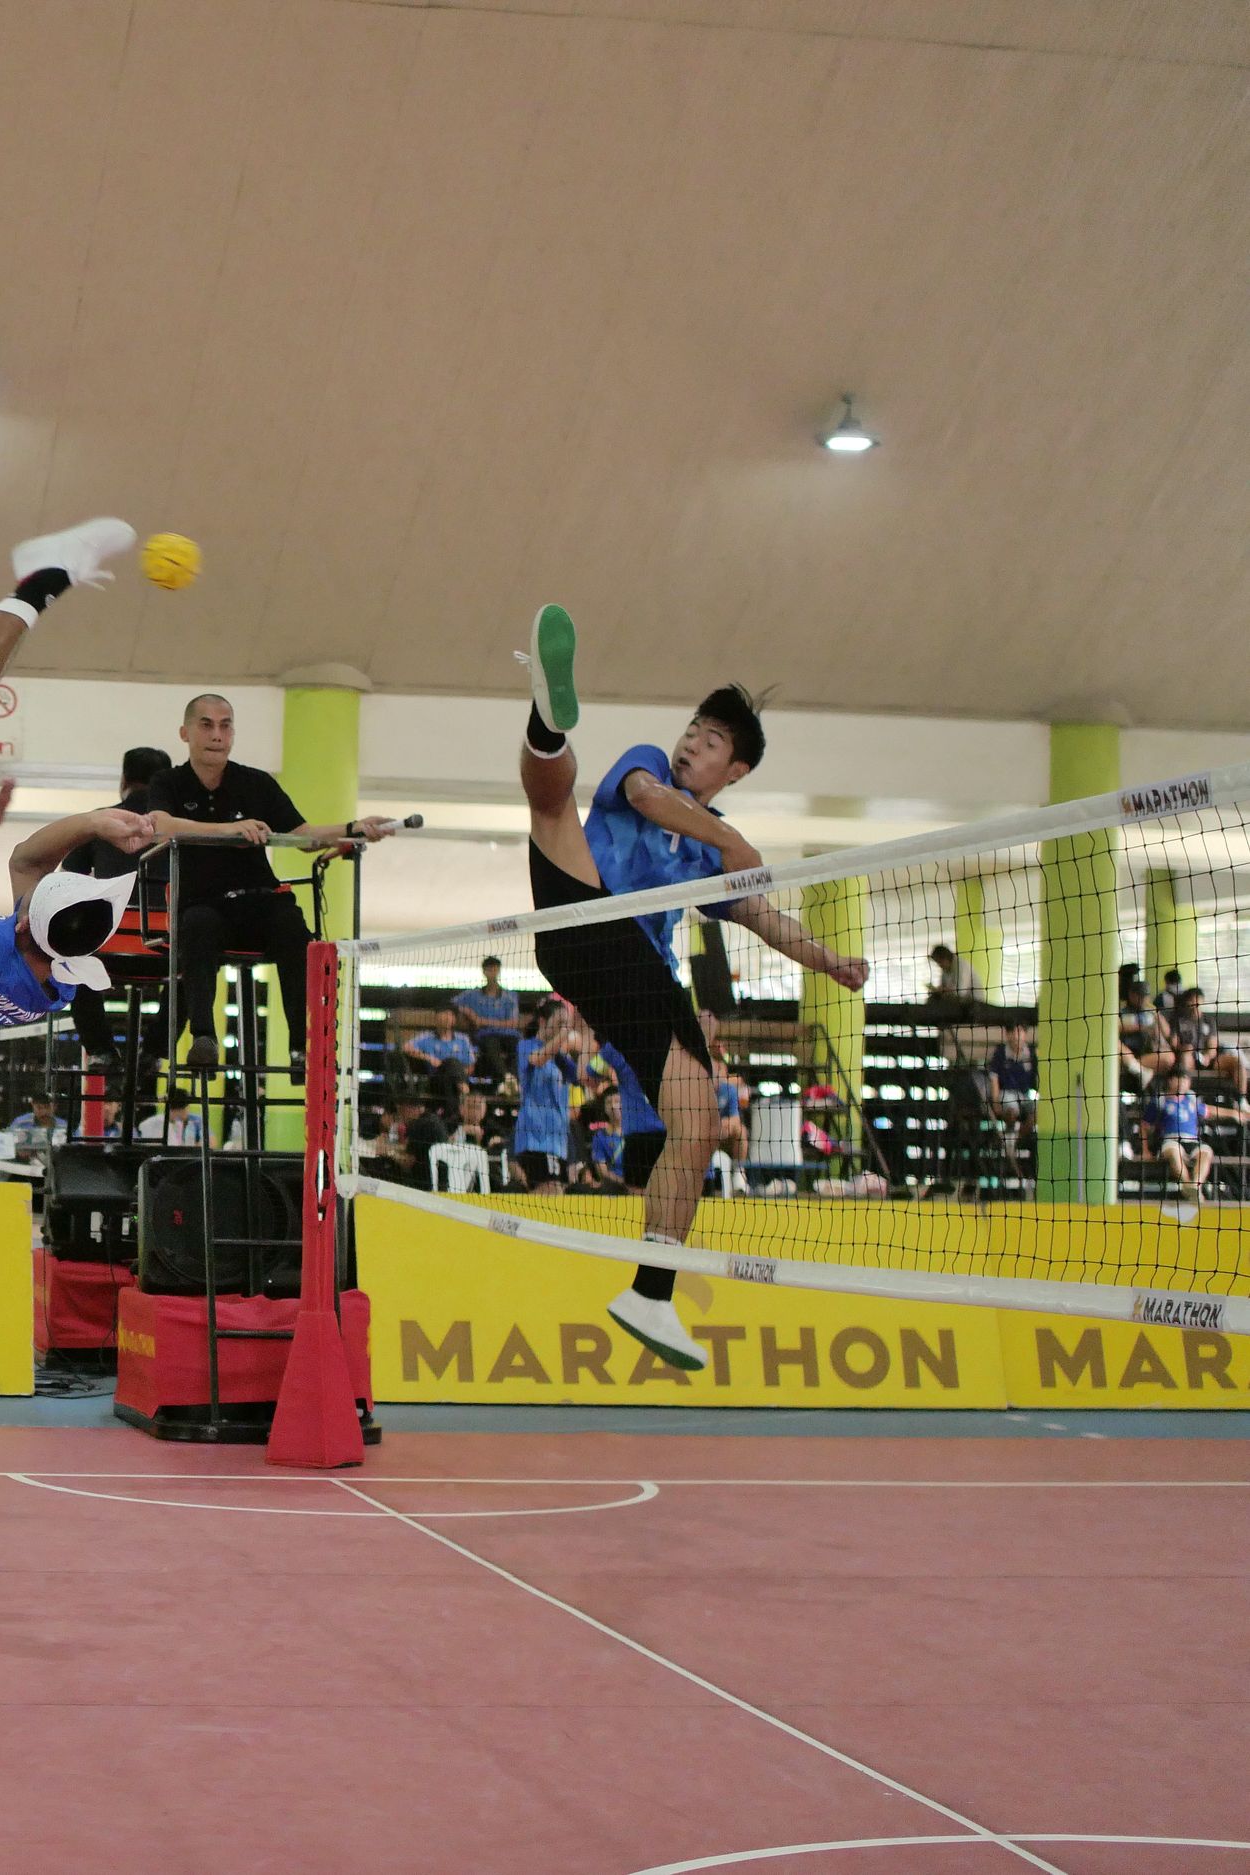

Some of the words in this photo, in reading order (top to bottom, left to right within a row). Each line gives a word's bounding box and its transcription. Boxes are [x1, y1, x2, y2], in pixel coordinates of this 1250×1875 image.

[1131, 779, 1209, 818] MARATHON
[1143, 1297, 1223, 1328] MARATHON
[1034, 1327, 1250, 1391] MAR
